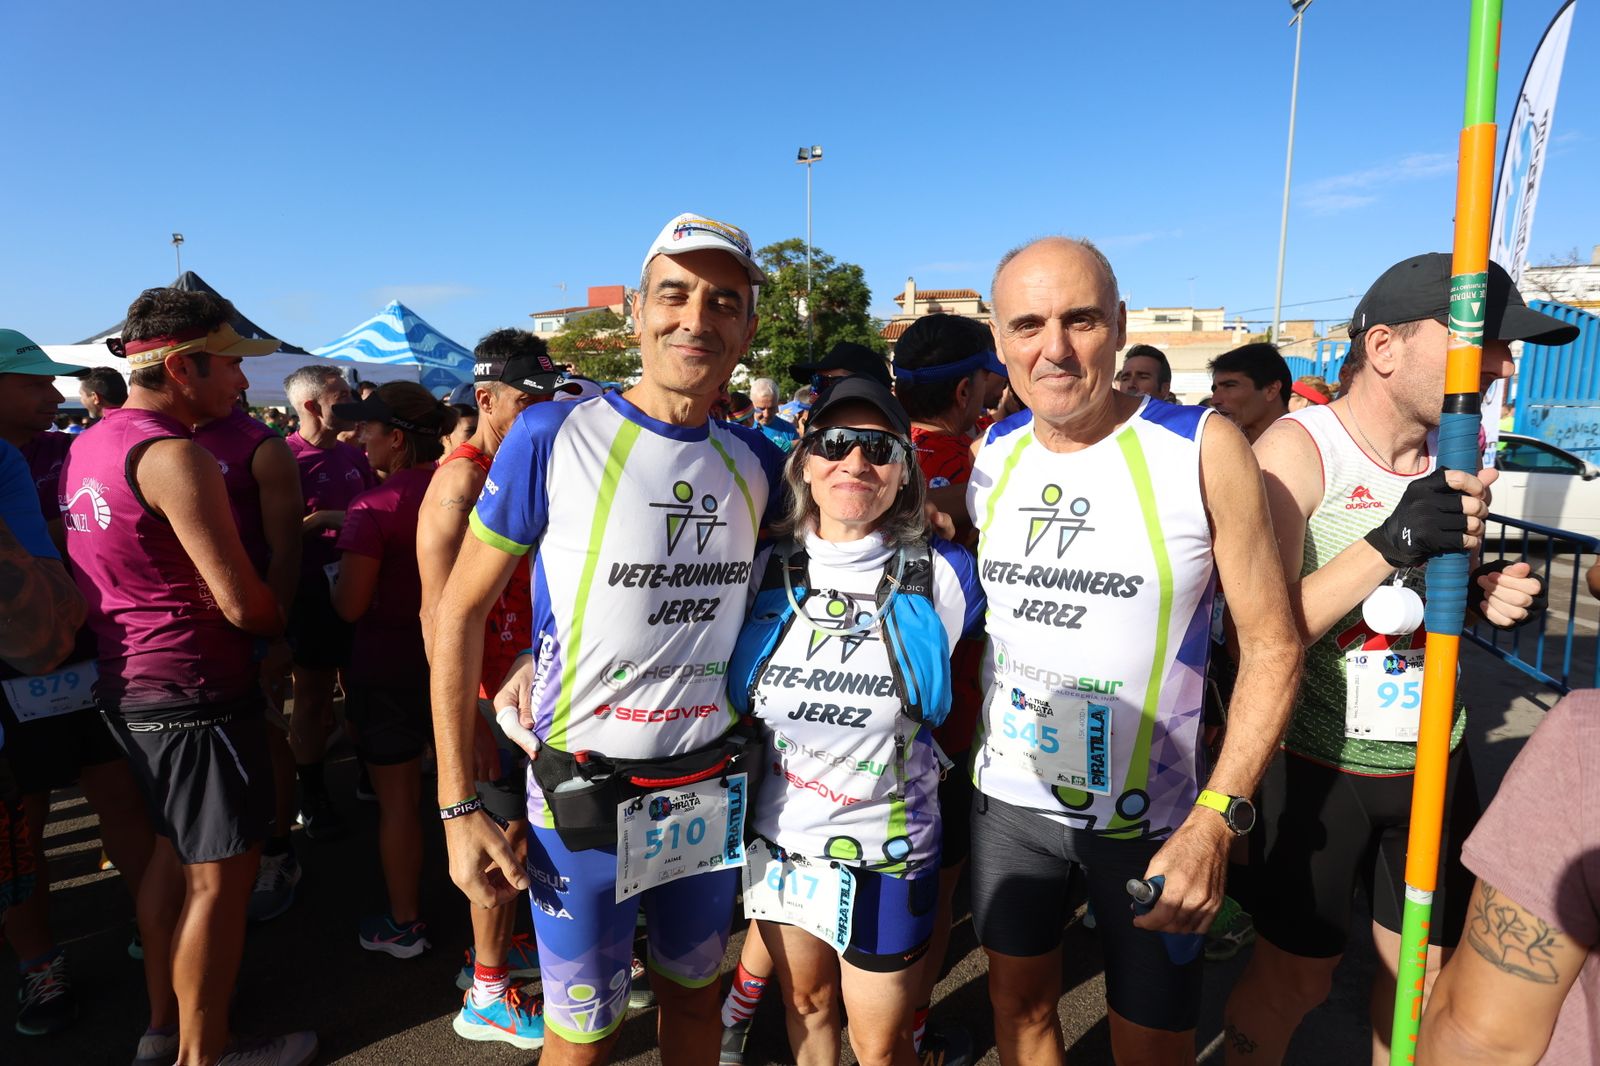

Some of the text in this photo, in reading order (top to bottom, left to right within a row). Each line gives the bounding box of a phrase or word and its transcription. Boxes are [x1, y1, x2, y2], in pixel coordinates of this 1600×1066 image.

[608, 561, 752, 588] VETE-RUNNERS
[982, 559, 1144, 598] VETE-RUNNERS
[647, 597, 720, 625] JEREZ
[1012, 598, 1087, 630] JEREZ
[28, 671, 80, 697] 879
[1377, 681, 1421, 709] 95
[615, 702, 720, 723] SECOVISA
[787, 701, 872, 728] JEREZ
[1003, 711, 1060, 754] 545
[1091, 709, 1106, 787] PIRATILLA
[670, 797, 701, 811] PIRATA
[727, 782, 742, 859] PIRATILLA
[644, 816, 706, 860] 510
[664, 855, 682, 864] JAIME
[767, 866, 819, 900] 617
